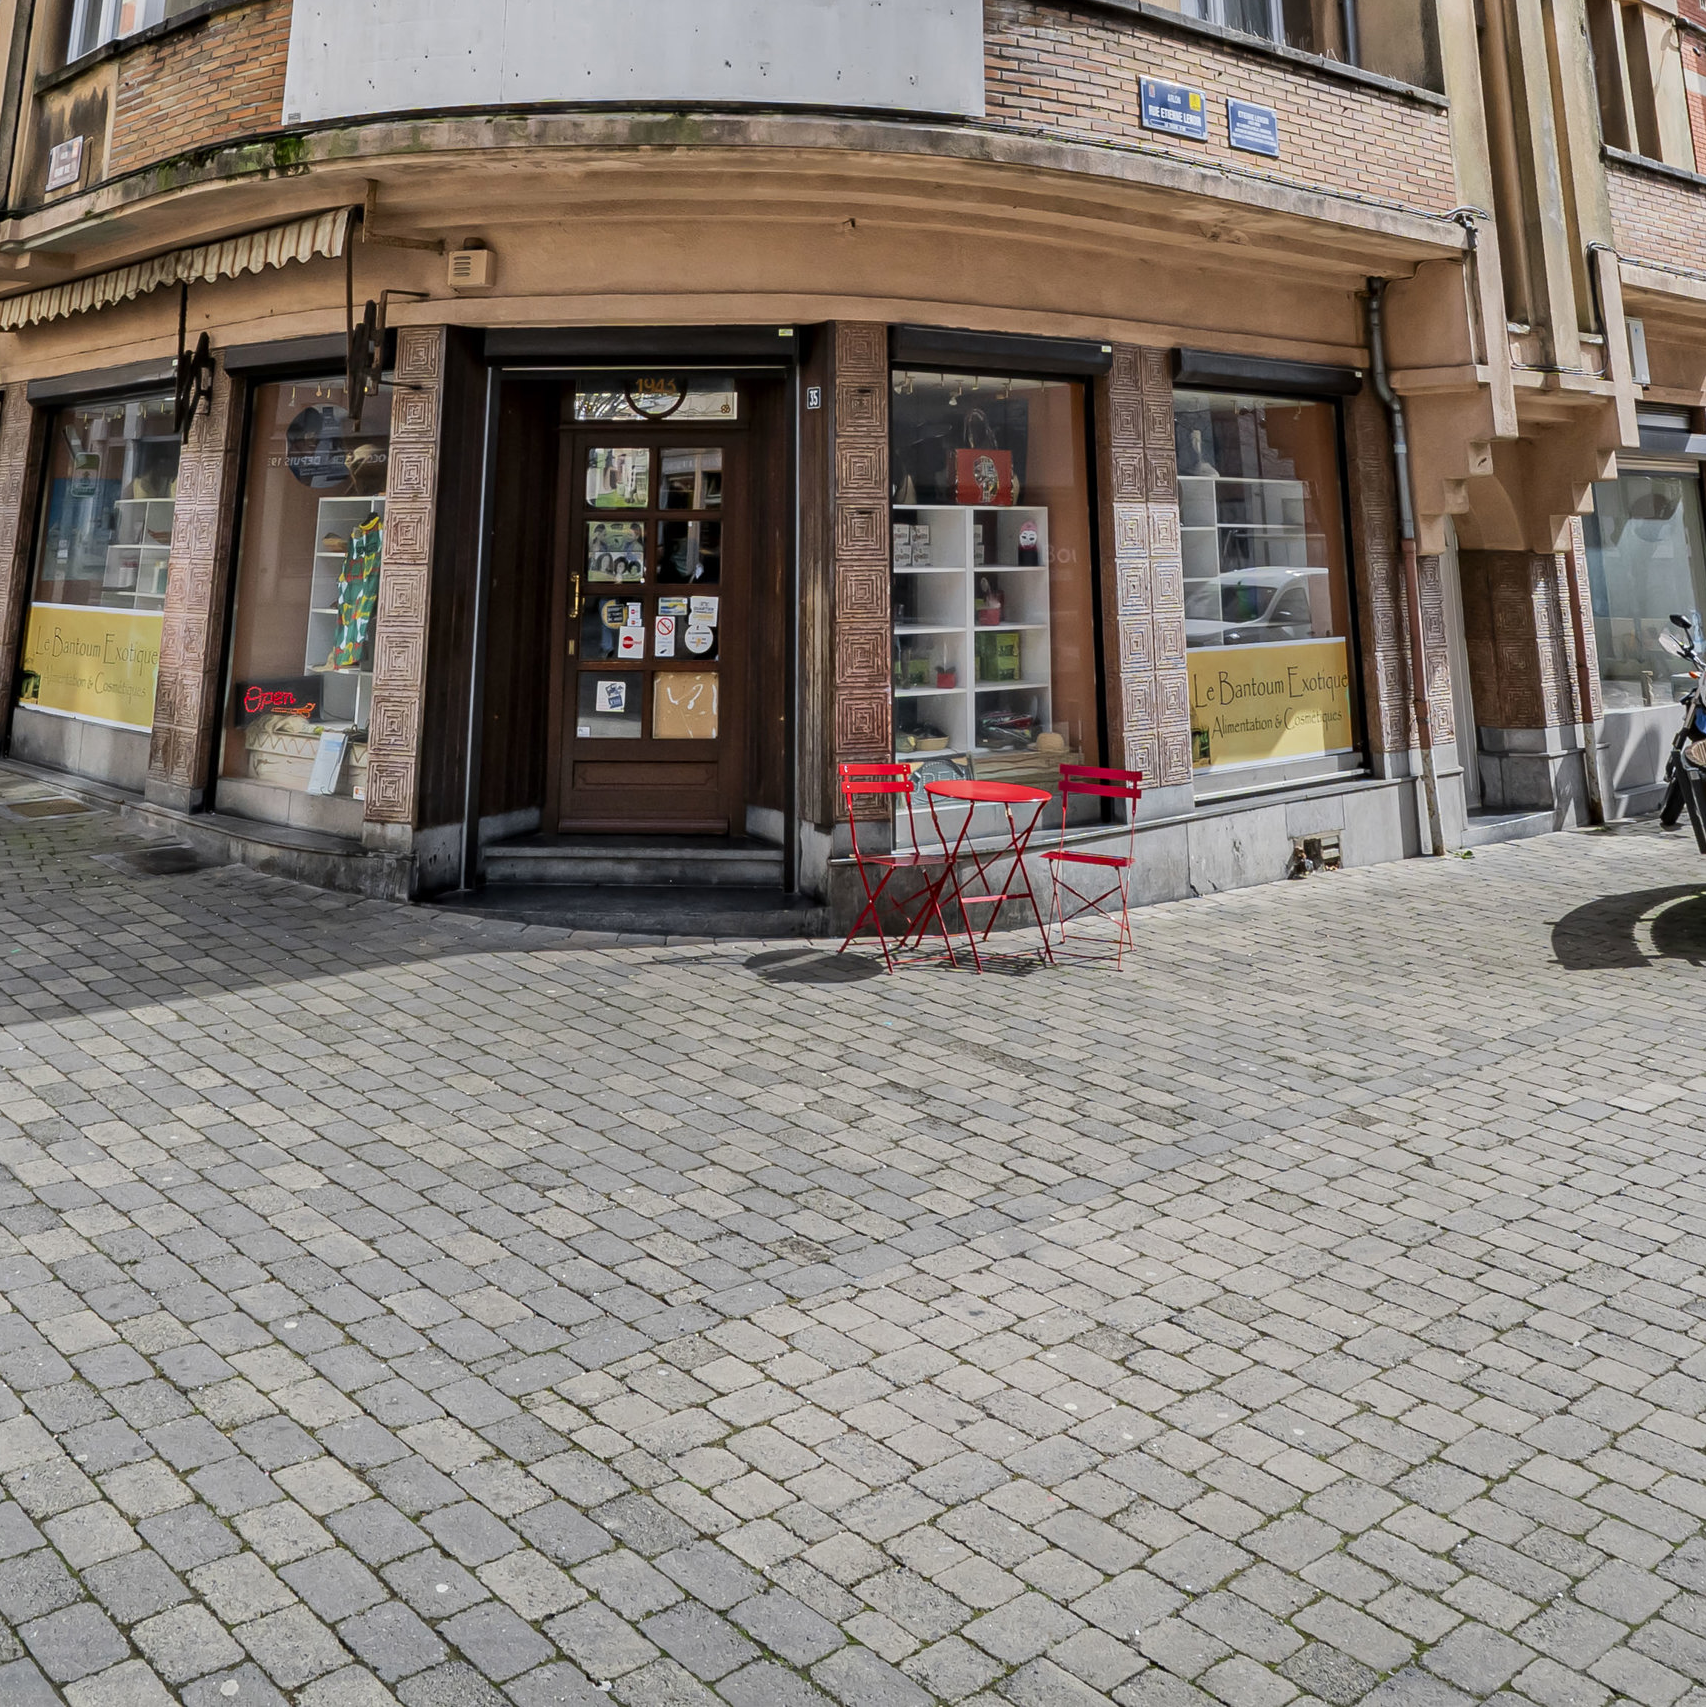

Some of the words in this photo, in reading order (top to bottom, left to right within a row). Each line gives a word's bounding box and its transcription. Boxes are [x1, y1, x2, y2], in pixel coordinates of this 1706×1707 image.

[1148, 105, 1160, 117] RUE
[809, 390, 818, 406] 35
[35, 625, 50, 655] Le
[51, 627, 101, 658] Bantoum
[103, 633, 158, 677] Exotique
[244, 686, 296, 712] Open
[1194, 673, 1215, 708] Le
[1218, 671, 1284, 706] Bantoum
[1287, 665, 1348, 702] Exotique
[1211, 714, 1273, 739] Alimentation
[1275, 713, 1282, 729] &
[1284, 707, 1342, 730] Cosmétiques
